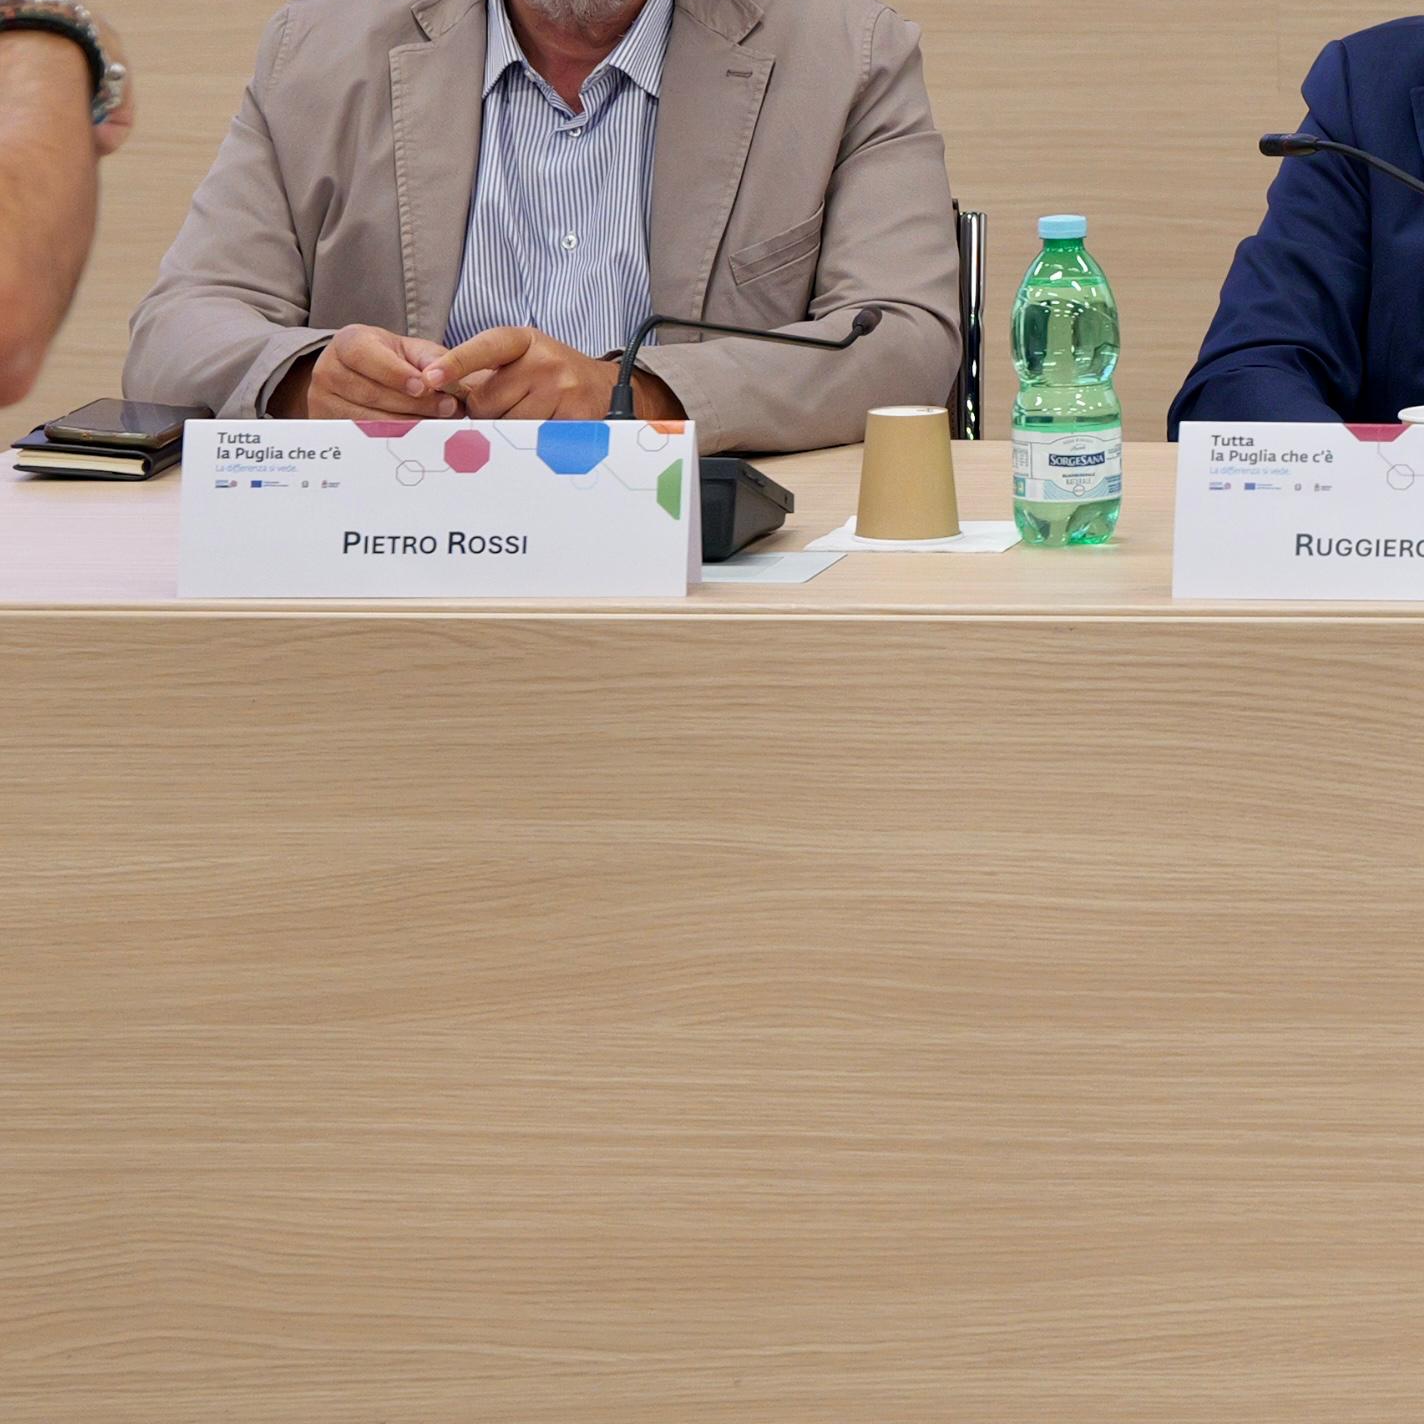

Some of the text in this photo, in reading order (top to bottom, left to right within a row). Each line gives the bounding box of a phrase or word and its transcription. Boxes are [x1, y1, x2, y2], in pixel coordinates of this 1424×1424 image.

[217, 432, 261, 444] Tutta
[1211, 435, 1254, 446] Tutta
[216, 446, 230, 459] la
[235, 446, 283, 462] Puglia
[288, 447, 316, 459] che
[1049, 453, 1104, 466] SORGESANA
[1210, 449, 1224, 461] la
[1229, 449, 1277, 465] Puglia
[1281, 450, 1308, 463] che
[342, 531, 527, 555] PIETRO ROSSI
